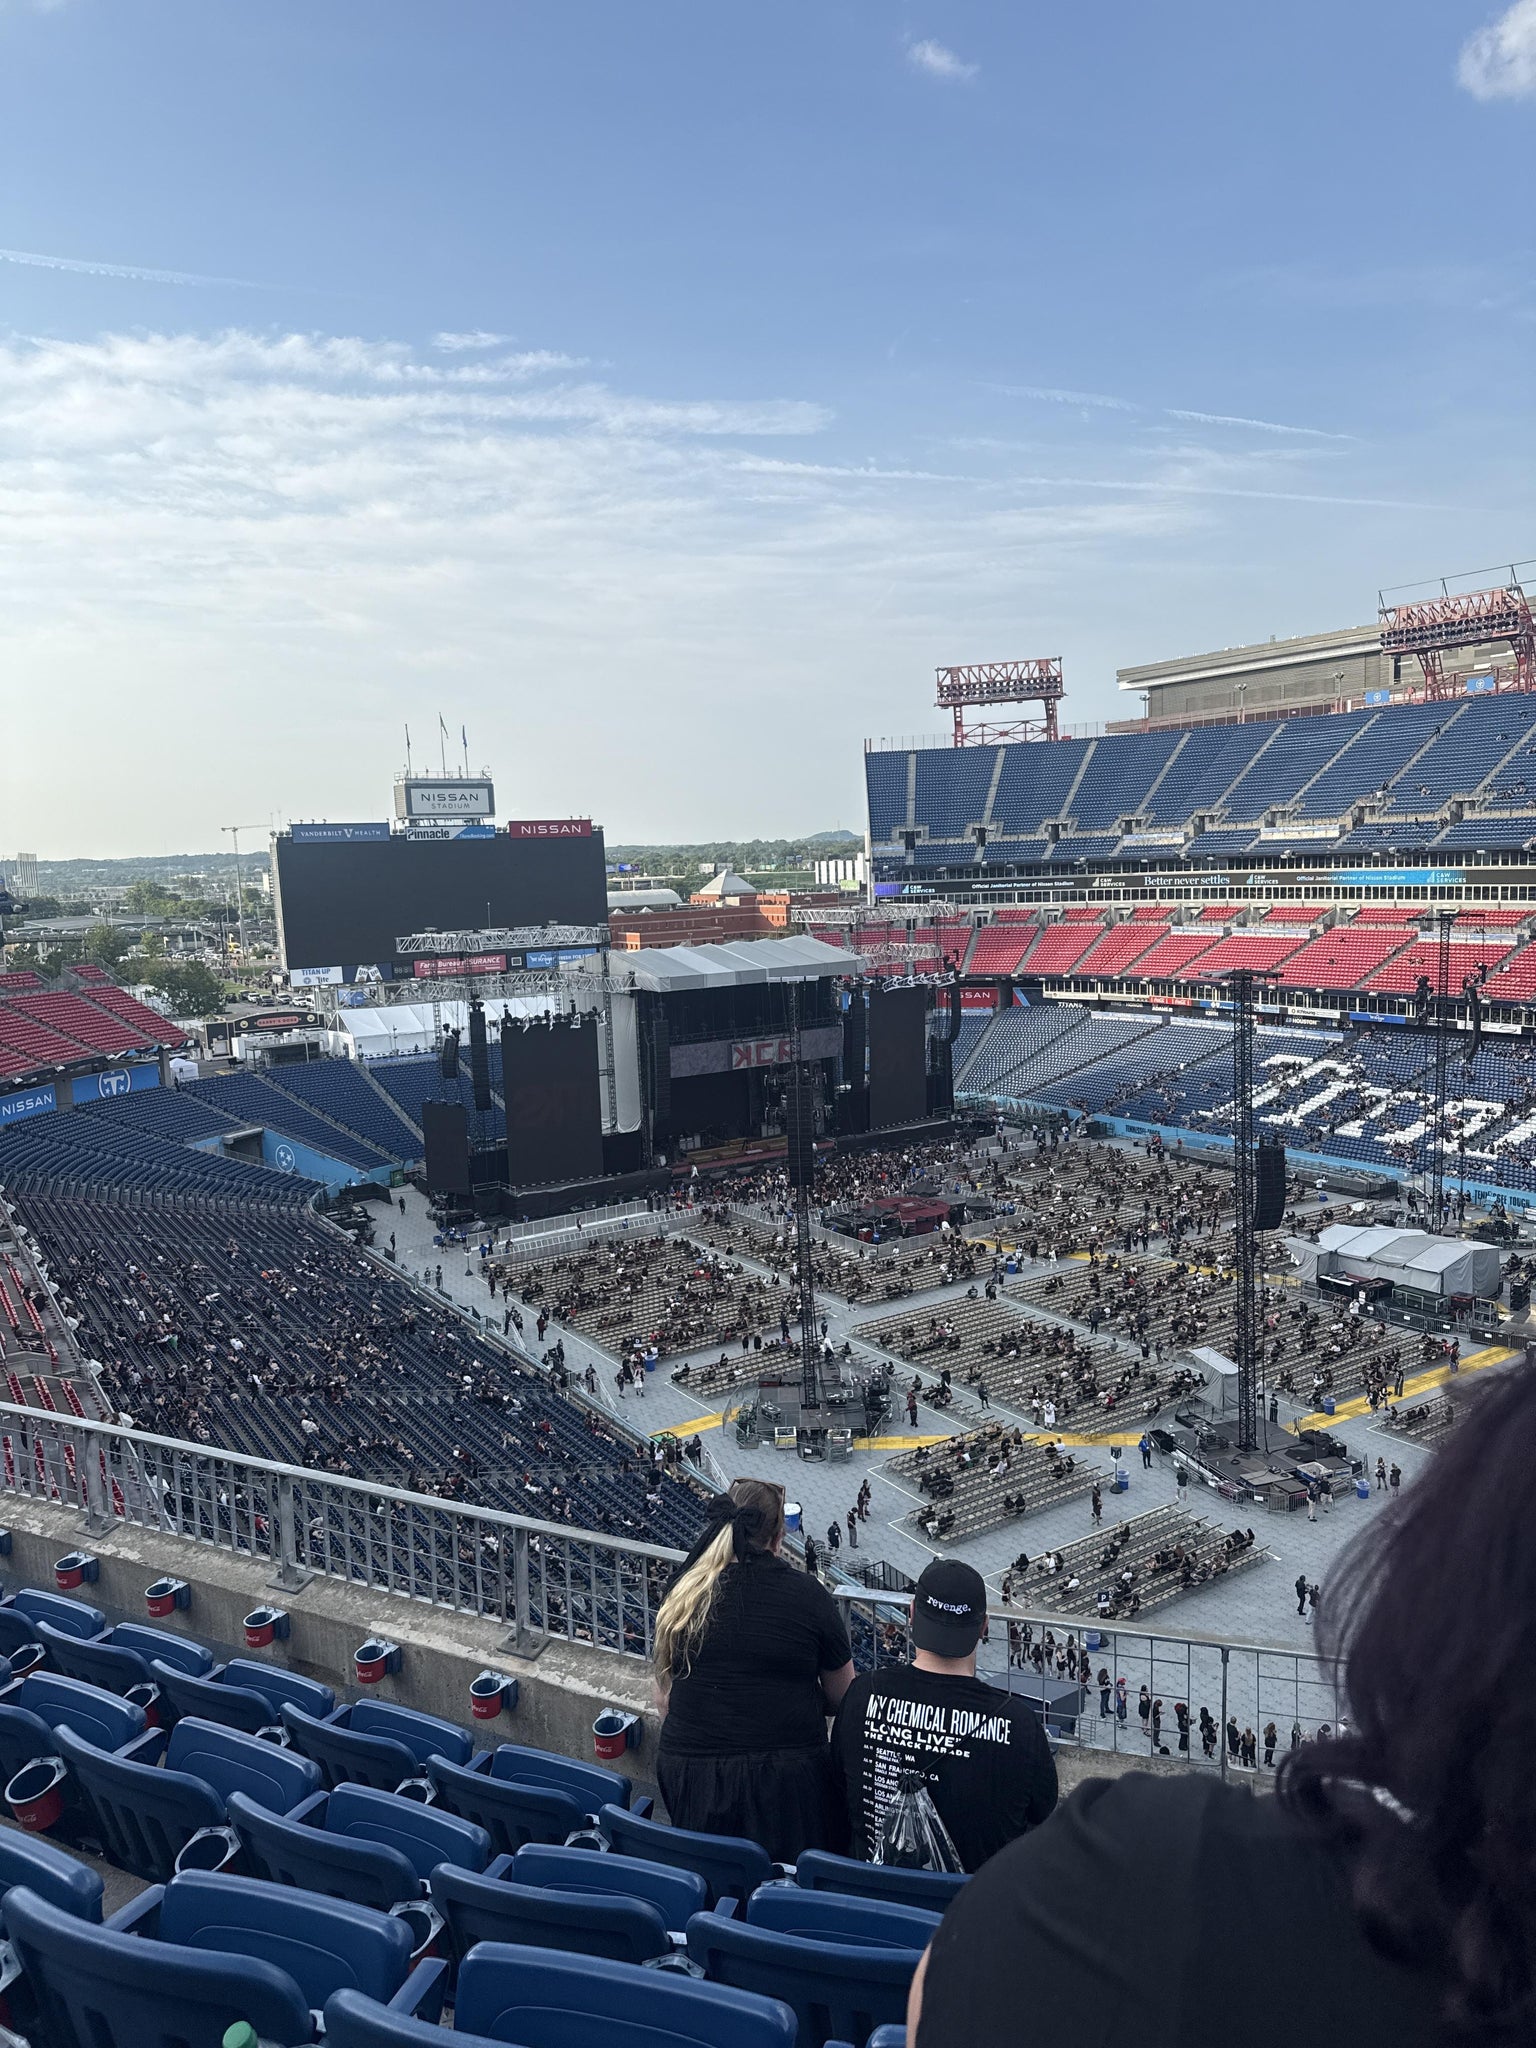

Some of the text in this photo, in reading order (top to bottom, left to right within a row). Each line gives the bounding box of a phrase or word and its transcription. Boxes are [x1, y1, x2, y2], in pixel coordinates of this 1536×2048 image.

[421, 792, 479, 802] NISSAN
[431, 802, 471, 810] STADIUM
[407, 828, 450, 840] Pinnacle
[521, 824, 582, 835] NISSAN
[1144, 874, 1230, 886] Better never settles
[437, 959, 461, 969] Bureau
[301, 967, 331, 977] TITAN UP
[943, 991, 991, 1000] NSSAN
[1292, 1017, 1318, 1026] HOUSTON
[2, 1093, 53, 1117] NISSAN
[1509, 1196, 1530, 1208] TOUGH
[1101, 1594, 1107, 1602] P
[927, 1595, 971, 1615] revenge.
[866, 1693, 1012, 1745] MY CHEMICAL ROMANCE
[863, 1730, 883, 1741] THE
[925, 1744, 971, 1758] PARADE
[916, 1731, 962, 1748] LIVE”
[904, 1753, 916, 1763] WA
[875, 1761, 887, 1770] SAN
[929, 1773, 939, 1782] CA
[874, 1775, 886, 1784] LOS
[874, 1788, 886, 1797] LOS
